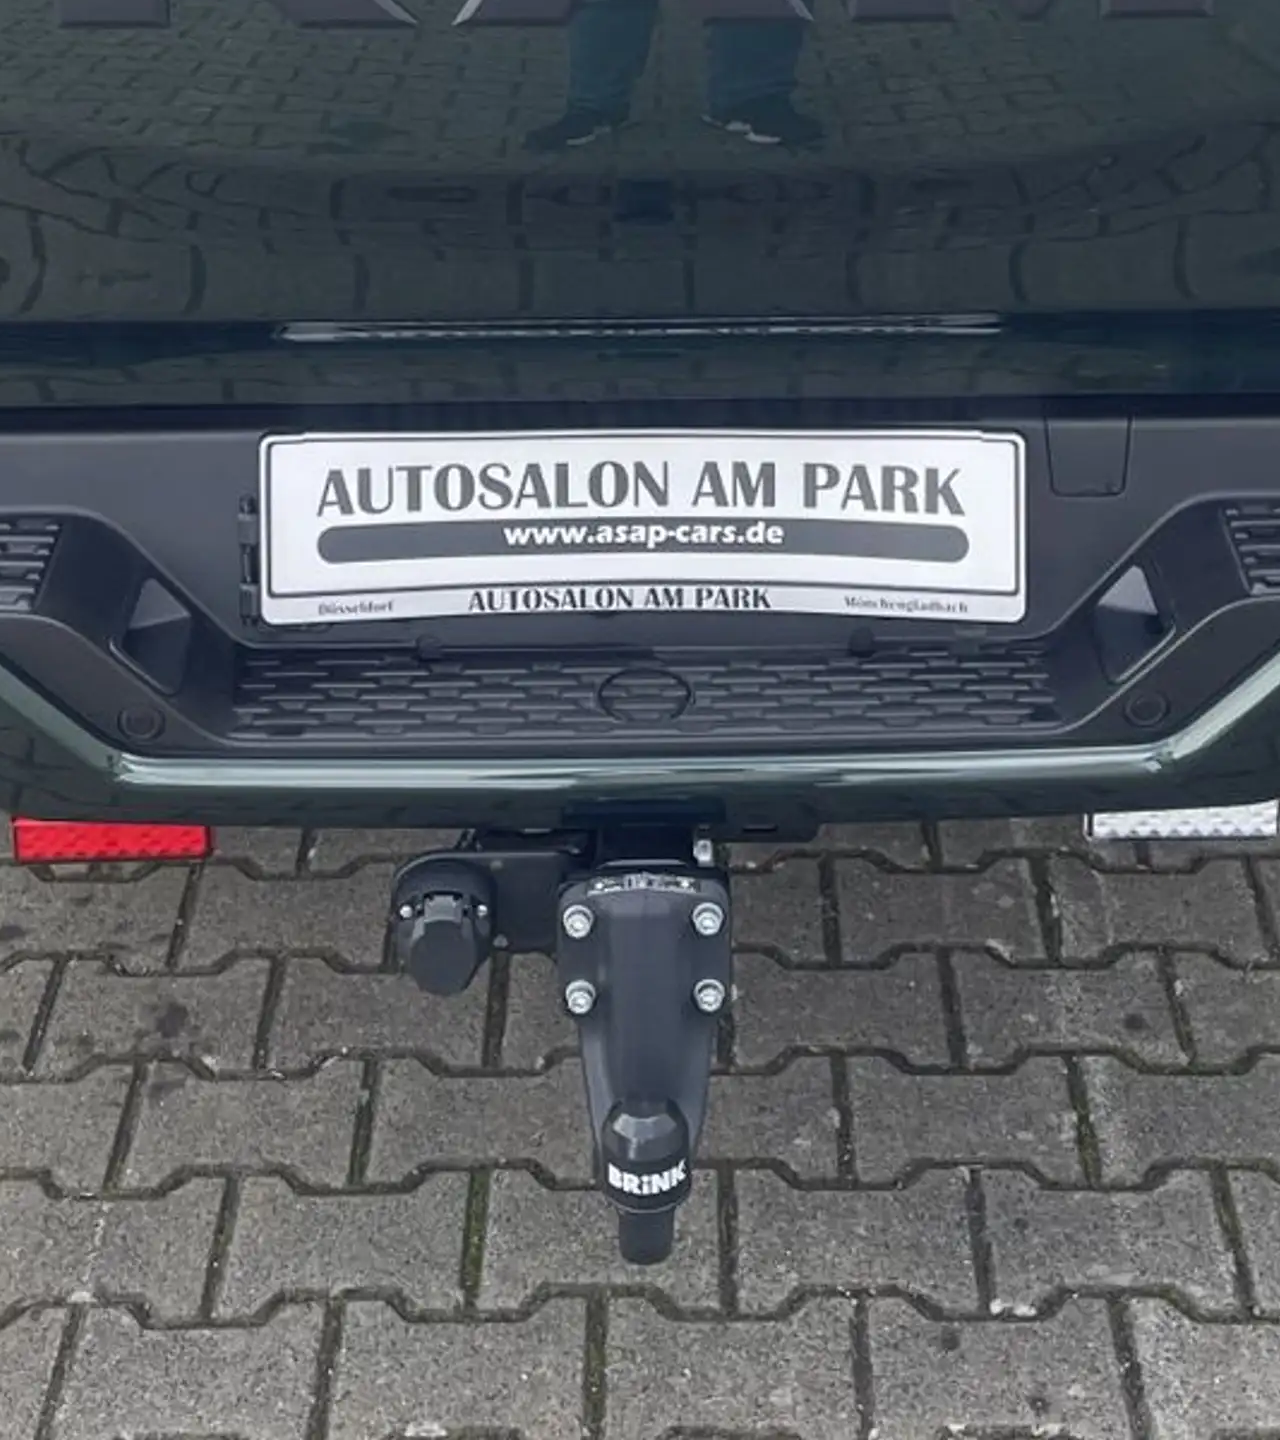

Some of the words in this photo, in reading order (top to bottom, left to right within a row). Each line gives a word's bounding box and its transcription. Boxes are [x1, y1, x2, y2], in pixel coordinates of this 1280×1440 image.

[317, 460, 669, 517] AUTOSALON
[692, 461, 776, 508] AM
[803, 462, 966, 516] PARK
[504, 520, 785, 550] www.asap-cars.de
[468, 586, 634, 612] AUTOSALON
[643, 587, 684, 610] AM
[695, 587, 772, 610] PARK
